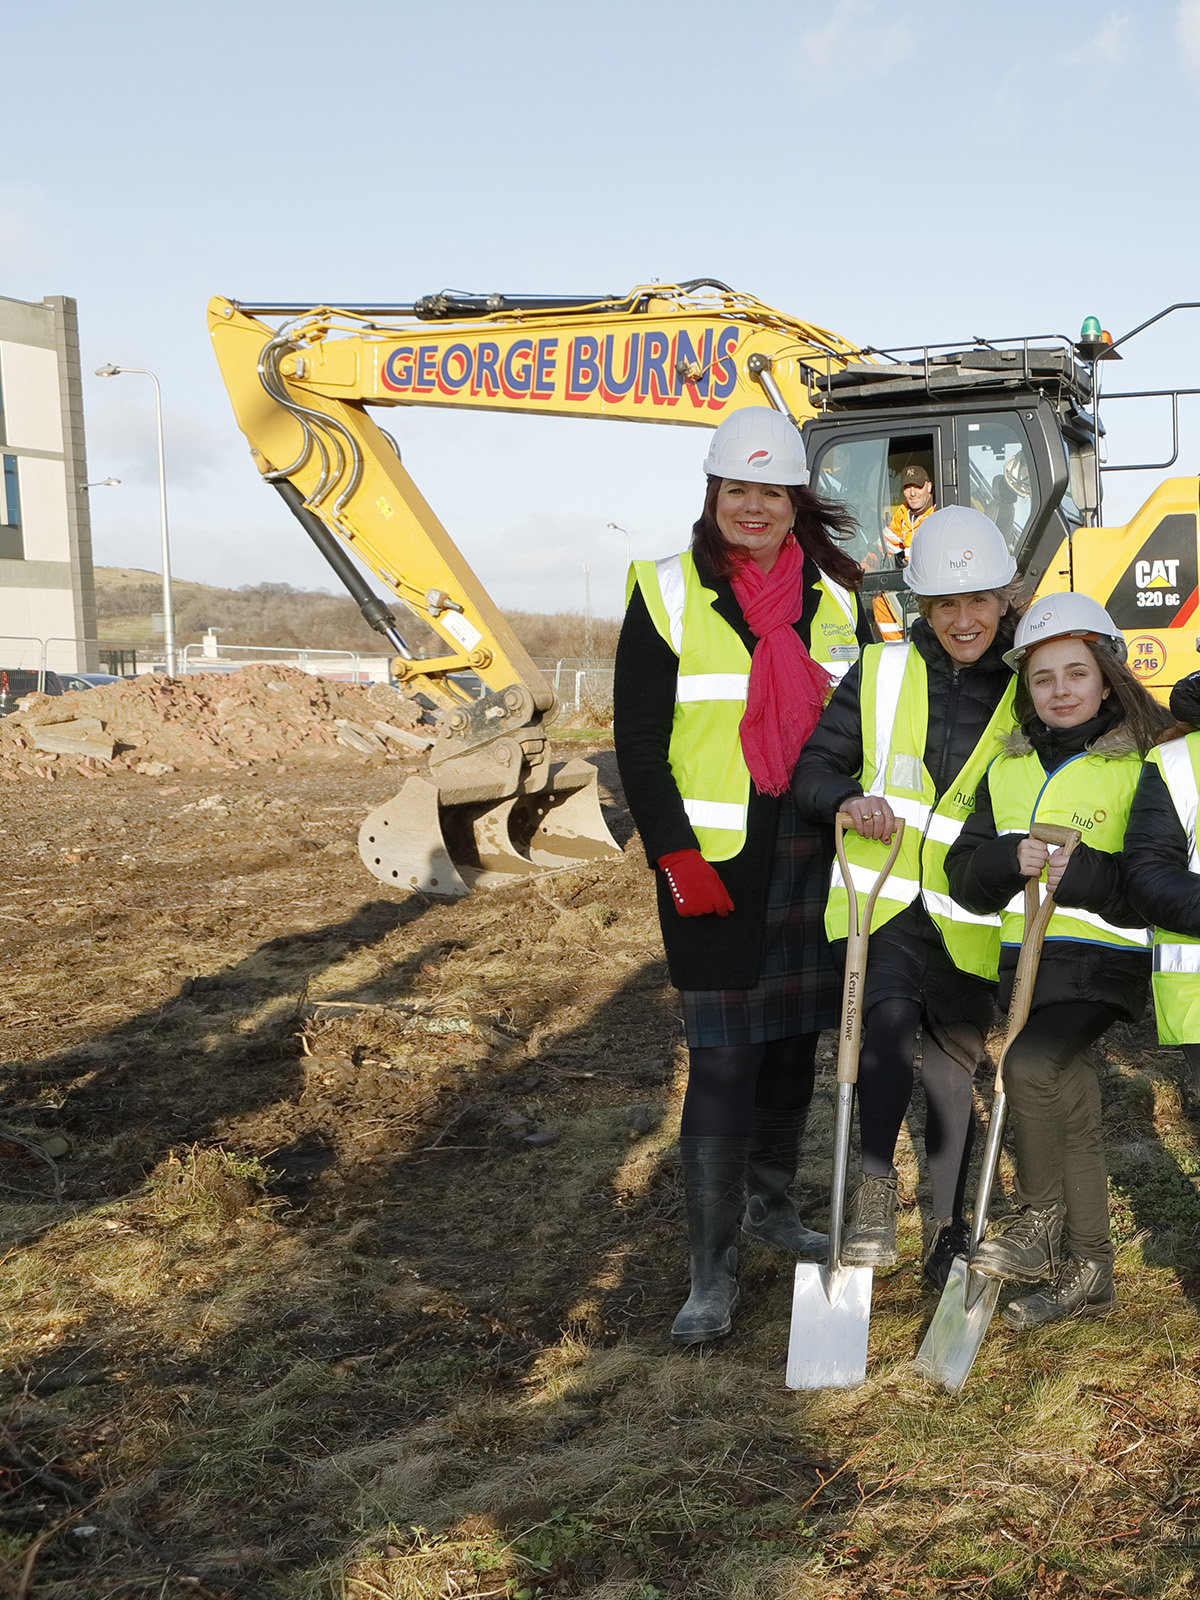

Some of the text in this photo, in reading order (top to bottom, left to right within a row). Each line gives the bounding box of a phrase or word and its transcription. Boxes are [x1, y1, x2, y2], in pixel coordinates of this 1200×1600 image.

[382, 325, 740, 410] GEORGE BURNS
[949, 558, 968, 569] hub
[1135, 559, 1180, 589] CAT
[1136, 591, 1180, 607] 320 GC
[1029, 620, 1046, 631] hub
[1137, 643, 1153, 654] TE
[1133, 658, 1158, 670] 216
[953, 788, 975, 808] hub
[1071, 812, 1094, 830] hub
[848, 971, 860, 998] Kent
[844, 1006, 857, 1041] Stowe
